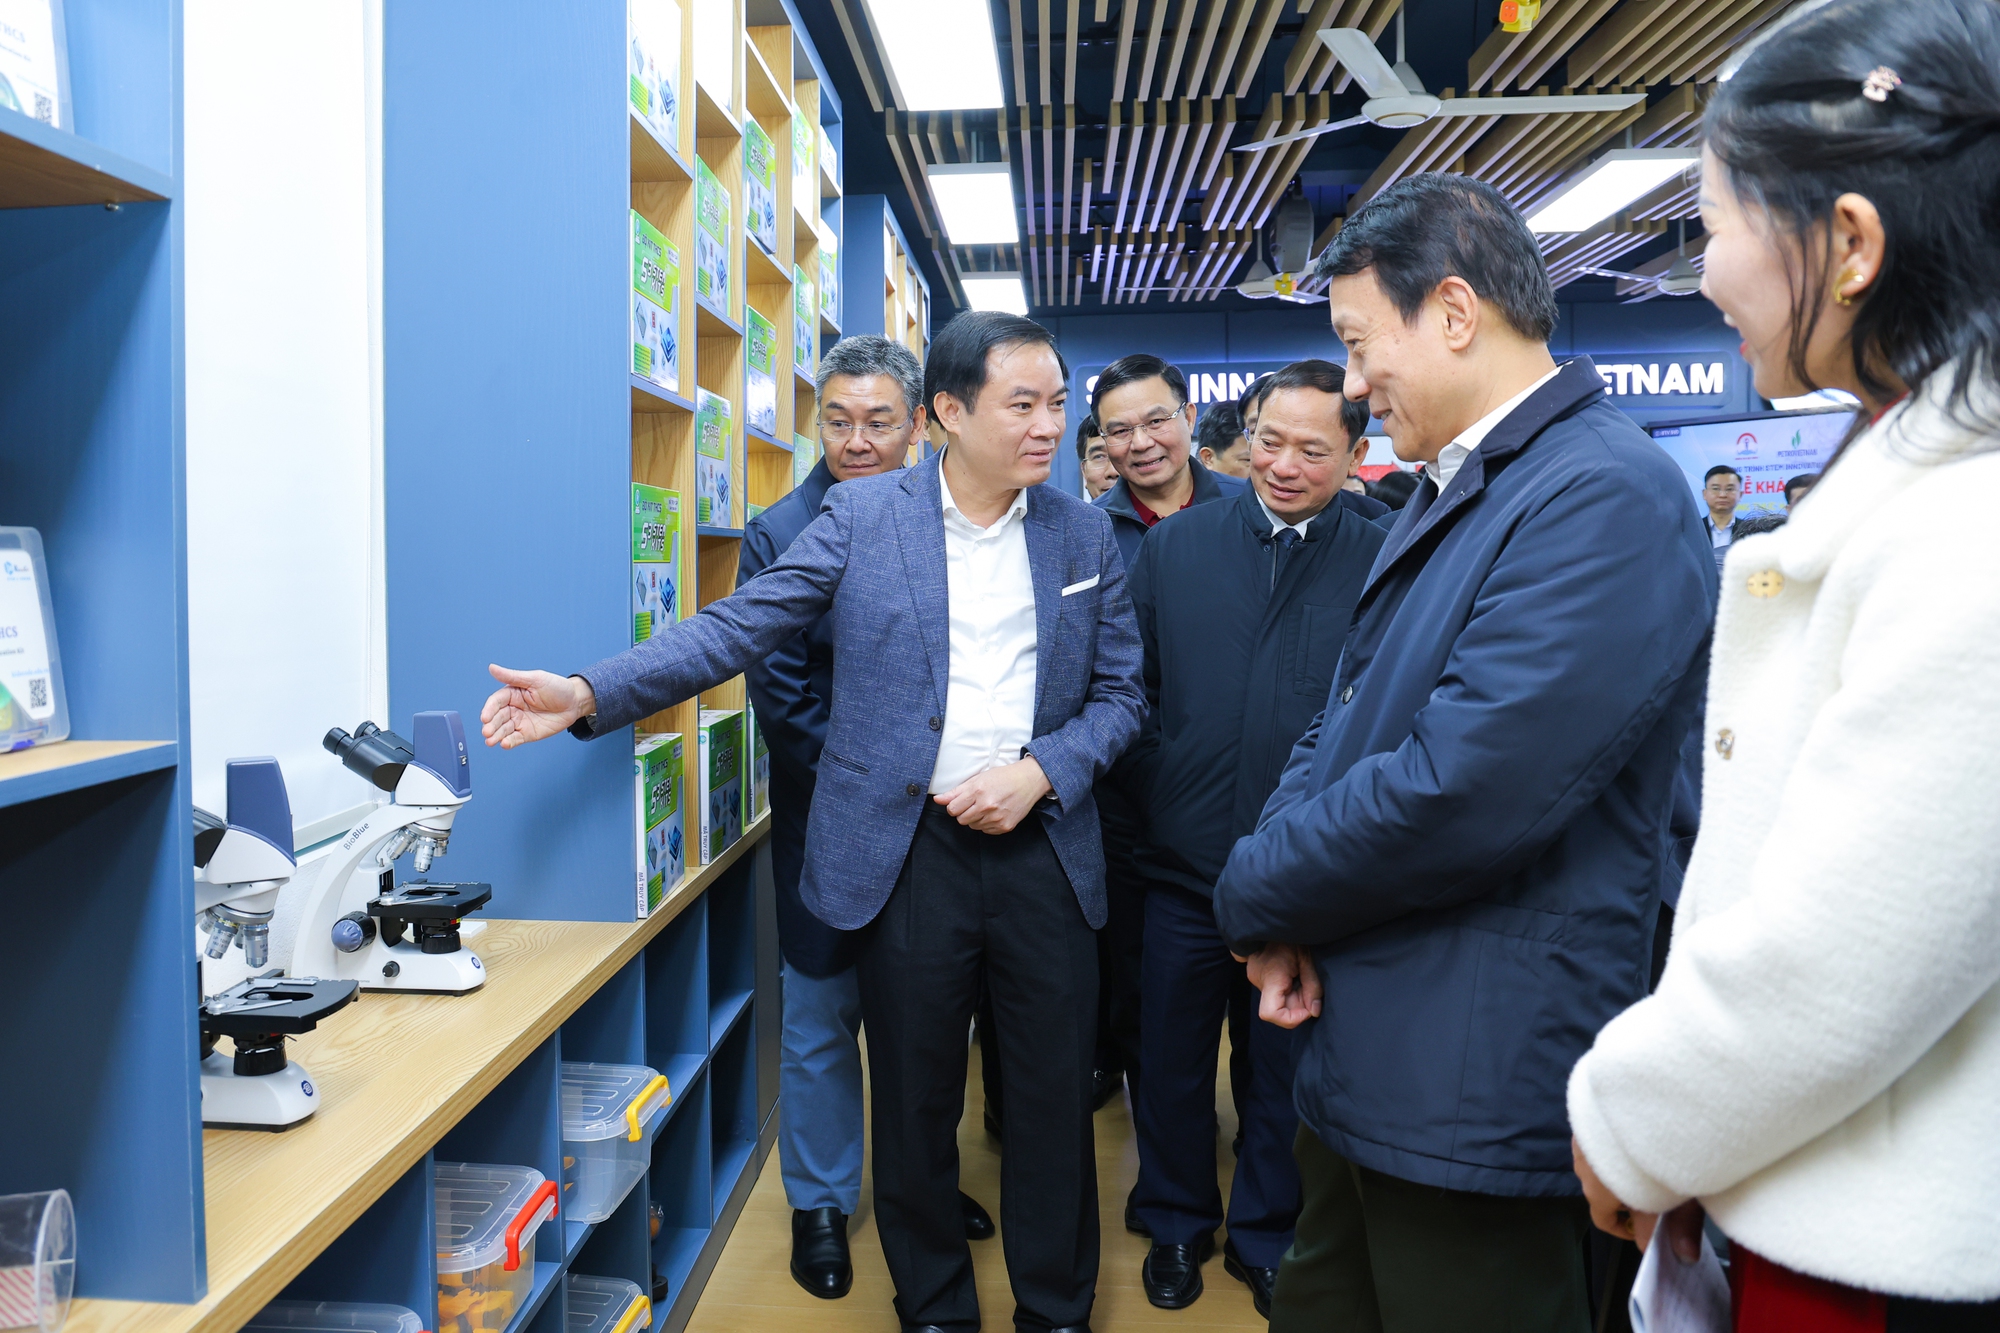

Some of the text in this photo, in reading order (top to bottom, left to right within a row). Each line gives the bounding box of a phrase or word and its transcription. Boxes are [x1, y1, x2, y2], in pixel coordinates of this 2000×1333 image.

[1756, 476, 1786, 494] KHÁ
[652, 523, 666, 537] STEM
[652, 538, 664, 552] KITS
[343, 822, 370, 850] BioBlue
